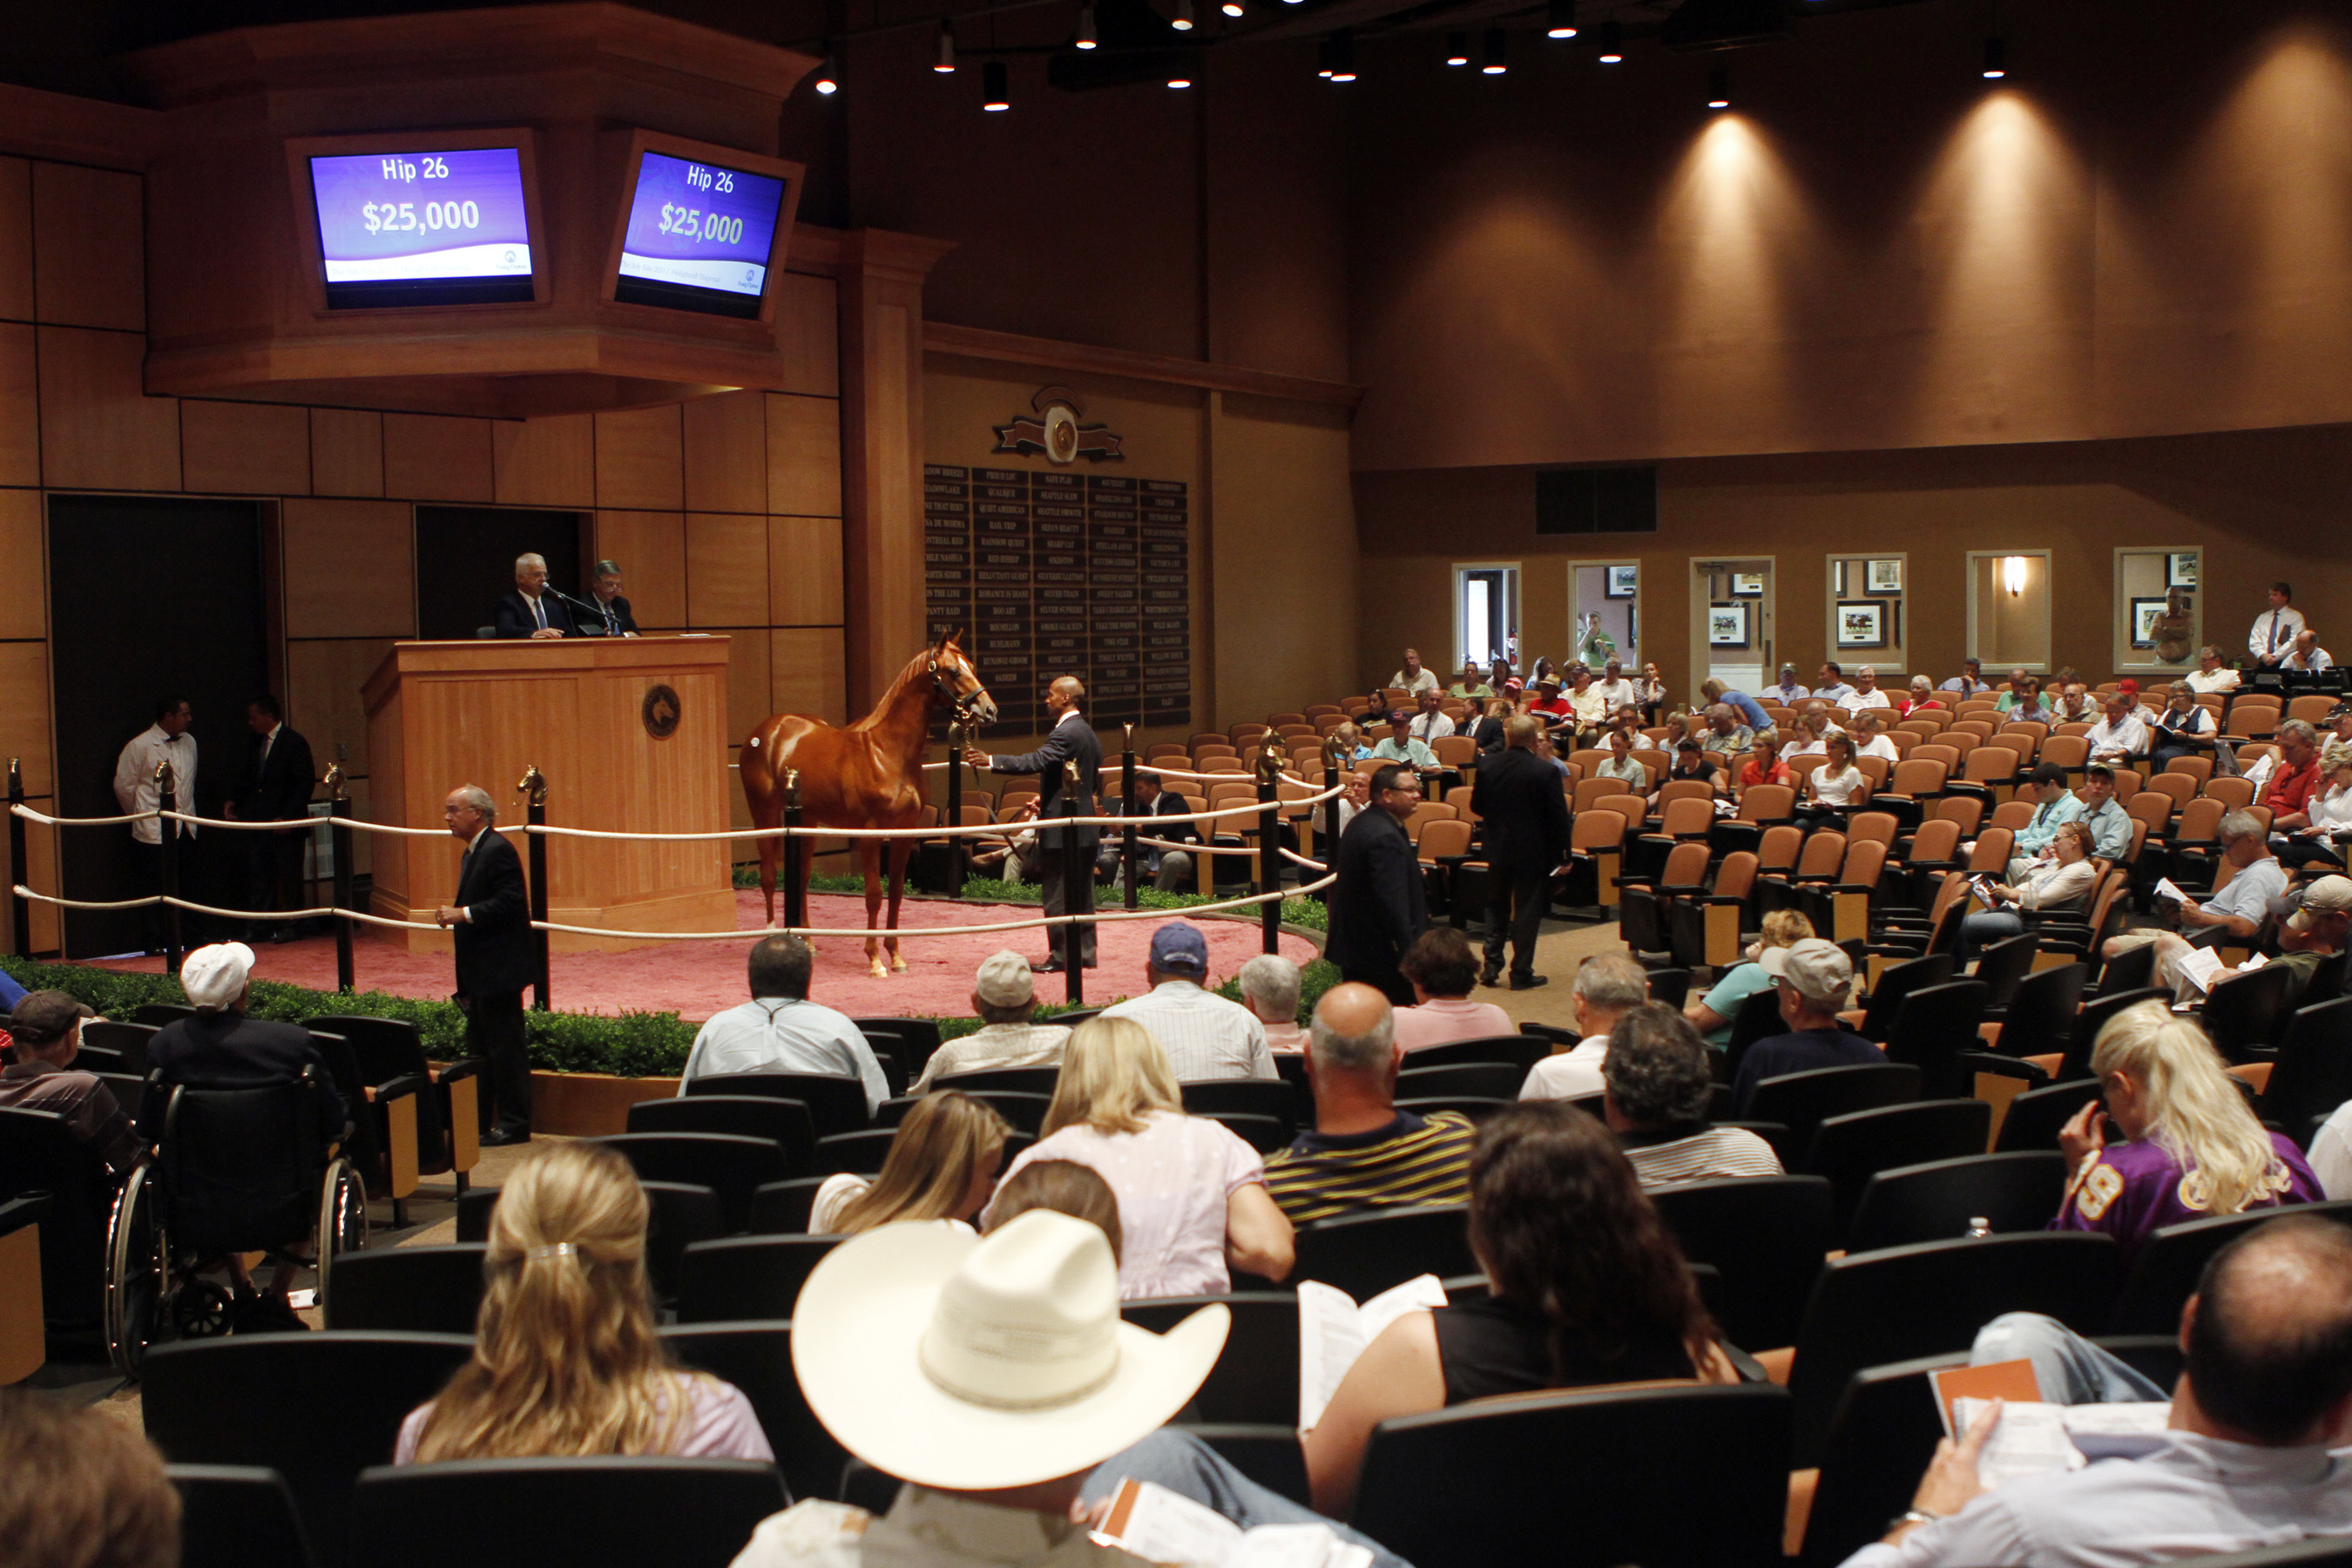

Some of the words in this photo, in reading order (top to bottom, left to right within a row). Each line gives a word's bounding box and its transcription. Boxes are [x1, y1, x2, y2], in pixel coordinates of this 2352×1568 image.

[382, 159, 416, 184] Hip
[422, 157, 449, 179] 26
[686, 165, 712, 192] Hip
[714, 172, 733, 193] 26
[362, 200, 479, 236] $25,000
[659, 201, 743, 245] $25,000
[986, 471, 1004, 480] PROUD
[1046, 476, 1059, 484] SAFE
[1041, 492, 1063, 500] SEATTLE
[934, 502, 948, 510] THAT
[979, 504, 996, 513] QUIET
[998, 506, 1025, 514] AMERICAN
[1037, 507, 1060, 516] SEATTLE
[990, 521, 1002, 529] RAIL
[981, 538, 1006, 546] RAINBOW
[1008, 539, 1024, 547] QUEST
[979, 572, 1010, 580] RELUCTANT
